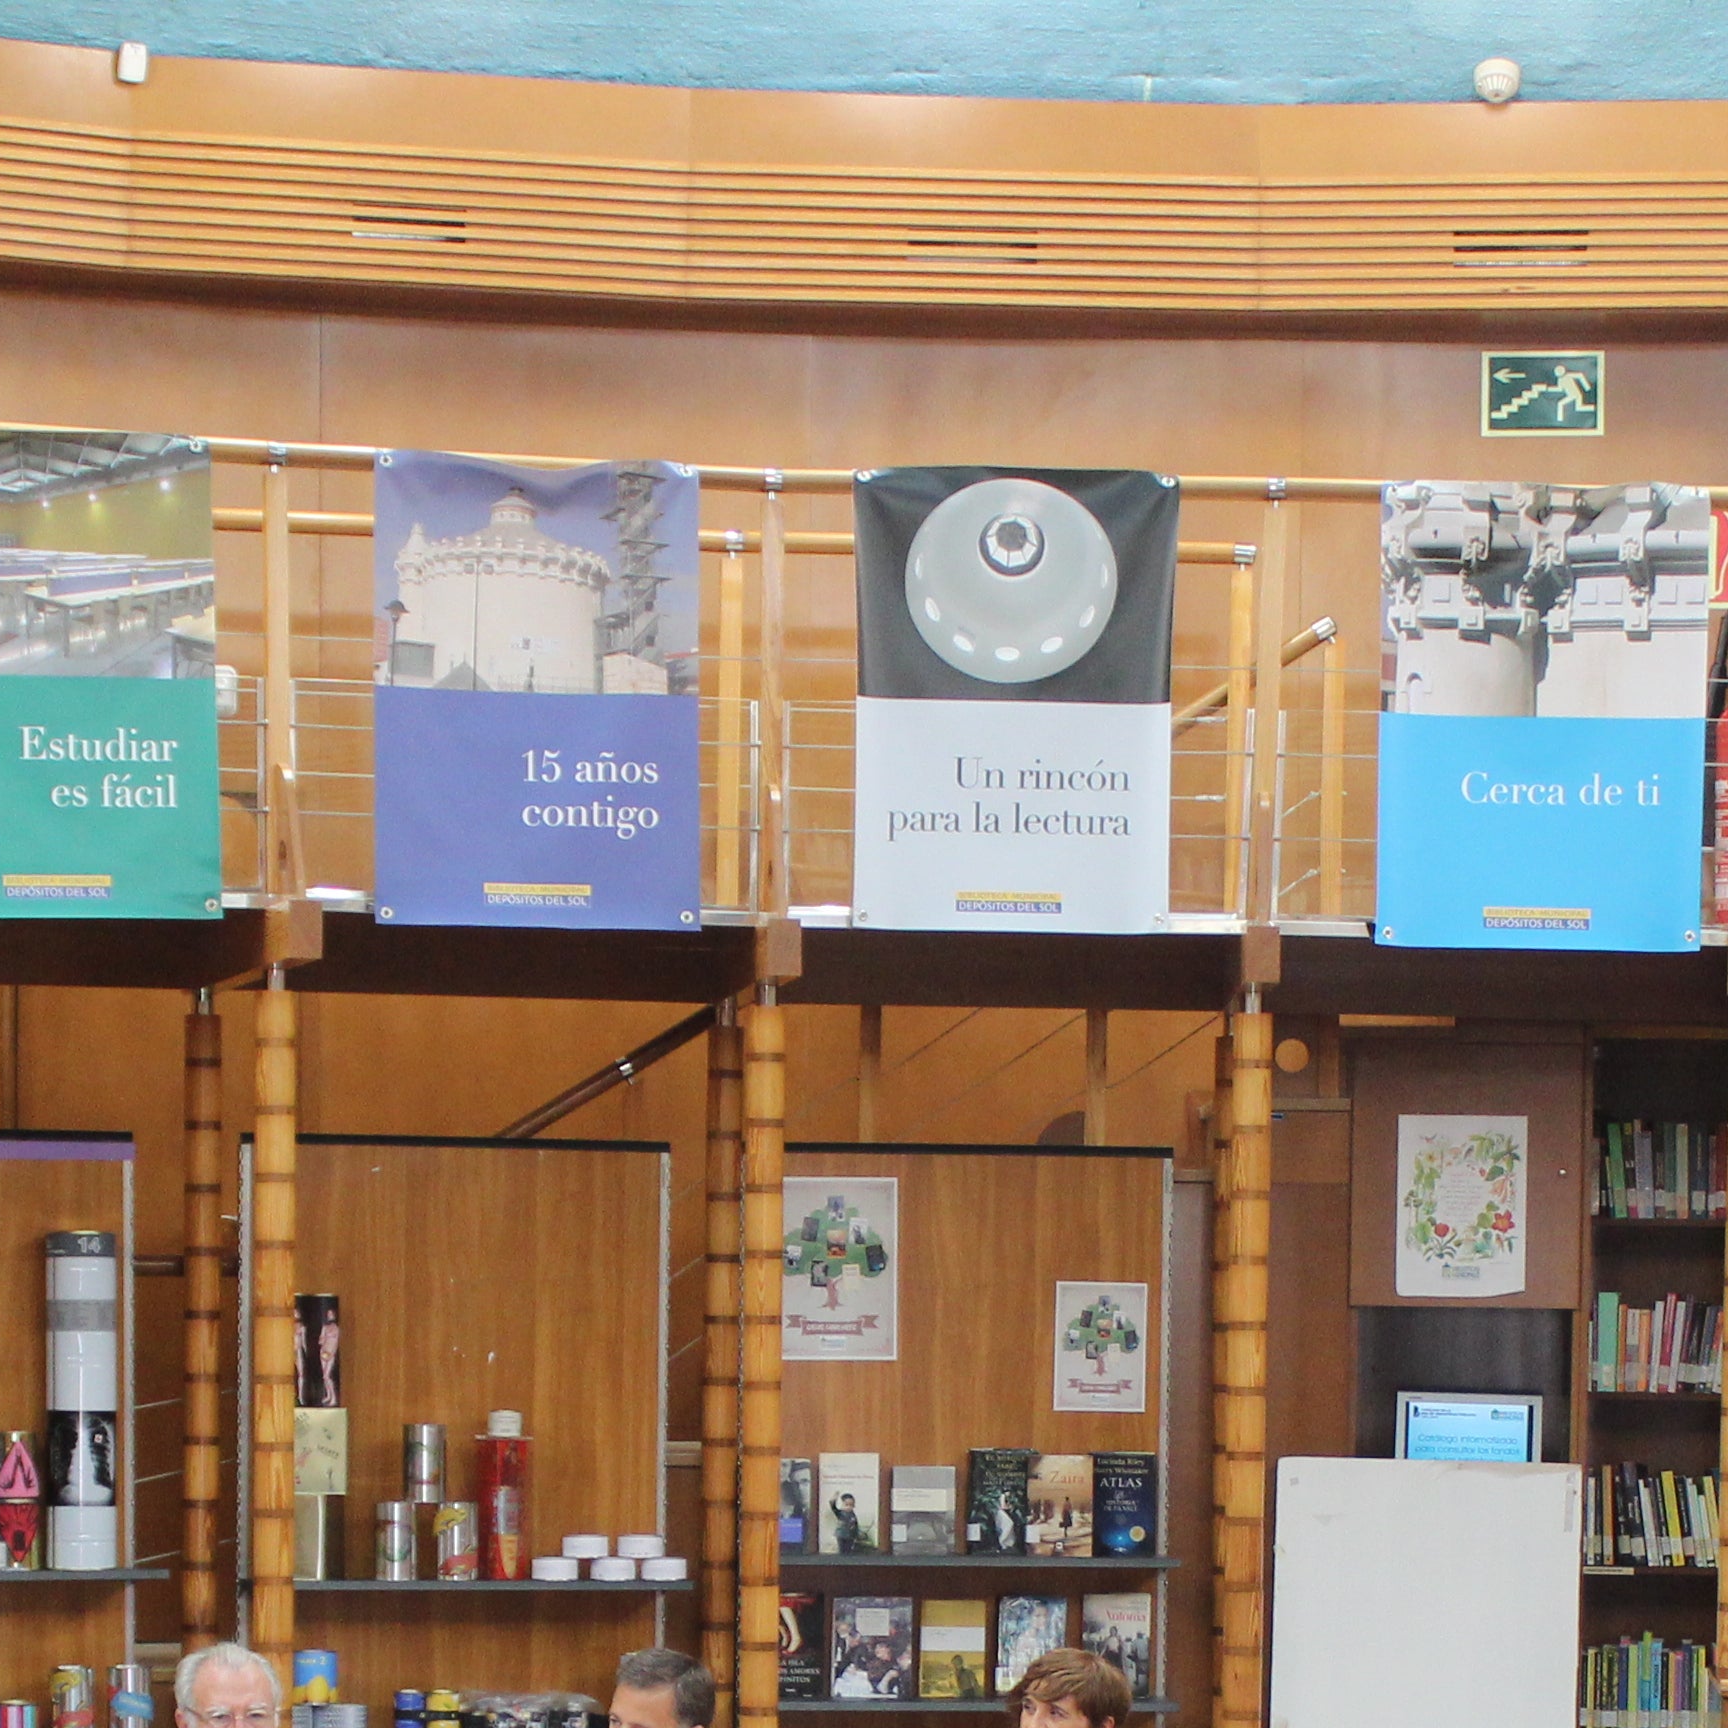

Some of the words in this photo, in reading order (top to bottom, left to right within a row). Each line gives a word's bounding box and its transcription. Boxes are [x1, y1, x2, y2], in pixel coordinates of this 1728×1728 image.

[19, 726, 179, 762] Estudiar
[521, 750, 561, 783] 15
[575, 750, 660, 784] años
[954, 757, 1005, 790] Un
[1016, 759, 1130, 791] rincón
[51, 783, 89, 808] es
[101, 773, 179, 809] fácil
[1460, 771, 1566, 806] Cerca
[1579, 773, 1624, 806] de
[1636, 773, 1661, 806] ti
[522, 795, 660, 840] contigo
[888, 808, 962, 841] para
[972, 801, 1001, 833] la
[1012, 803, 1131, 836] lectura
[6, 884, 64, 898] DEPÓSITOS
[67, 887, 86, 898] DEL
[88, 887, 108, 899] SOL
[487, 893, 545, 905] DEPÓSITOS
[547, 895, 566, 906] DEL
[568, 895, 588, 907] SOL
[959, 900, 1015, 912] DEPÓSITOS
[1017, 902, 1036, 912] DEL
[1039, 902, 1059, 913] SOL
[1486, 917, 1542, 928] DEPÓSITOS
[1544, 919, 1564, 929] DEL
[1567, 919, 1588, 930] SOL
[77, 1236, 101, 1254] 14
[1418, 1434, 1459, 1445] Catálogo
[1460, 1435, 1518, 1445] informatizado
[1415, 1445, 1435, 1454] para
[1438, 1446, 1475, 1454] consultar
[1049, 1471, 1086, 1484] Zaira
[1100, 1477, 1143, 1488] ATLAS
